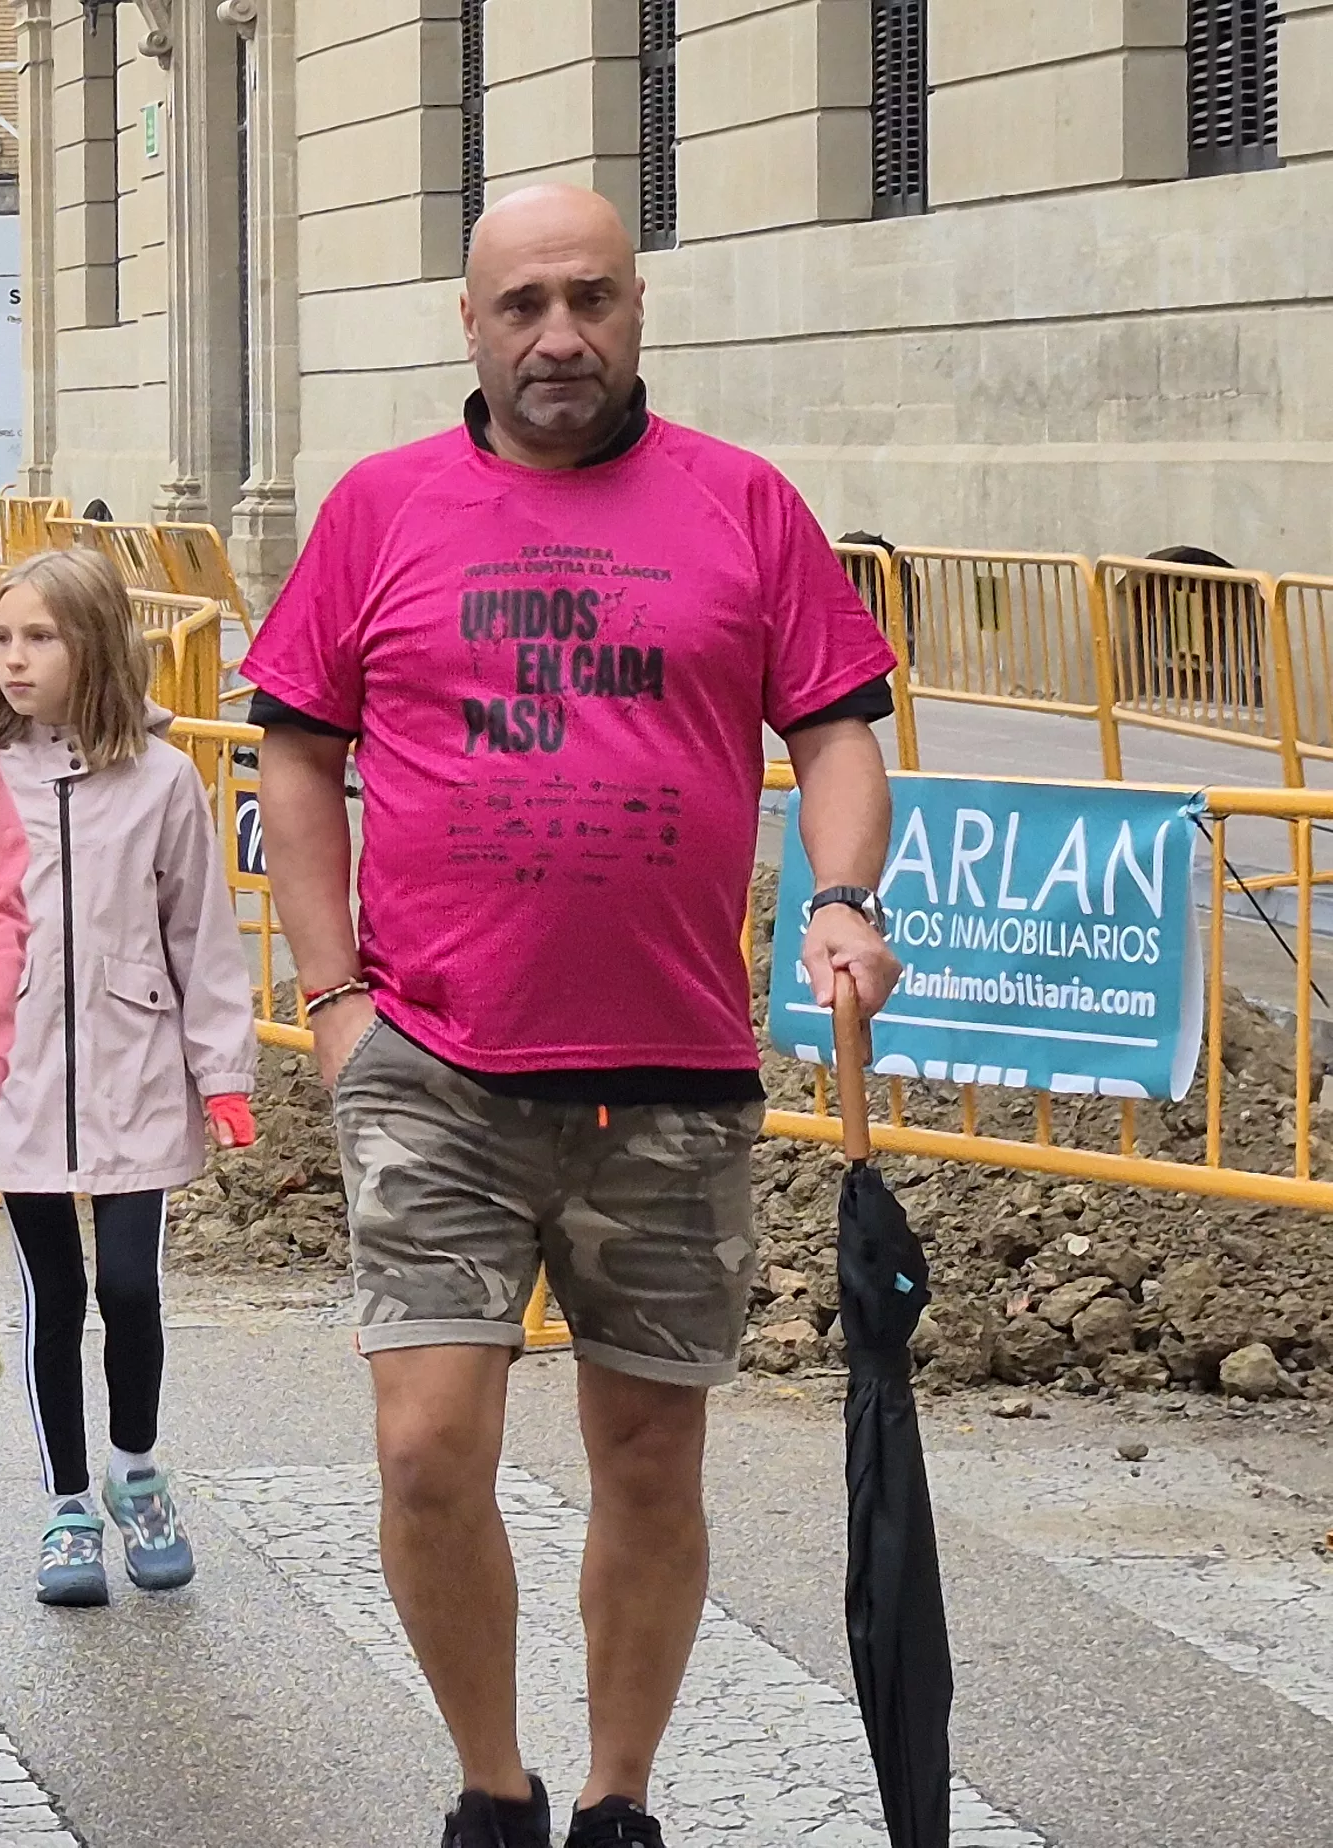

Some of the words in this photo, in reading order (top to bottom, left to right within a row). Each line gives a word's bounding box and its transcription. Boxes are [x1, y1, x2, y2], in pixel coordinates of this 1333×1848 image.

[460, 588, 600, 641] UNIDOS
[517, 644, 562, 694] EN
[572, 644, 664, 700] CADA
[463, 697, 565, 753] PASO
[878, 806, 1171, 919] ARLAN
[950, 912, 1161, 964] INMOBILIARIOS
